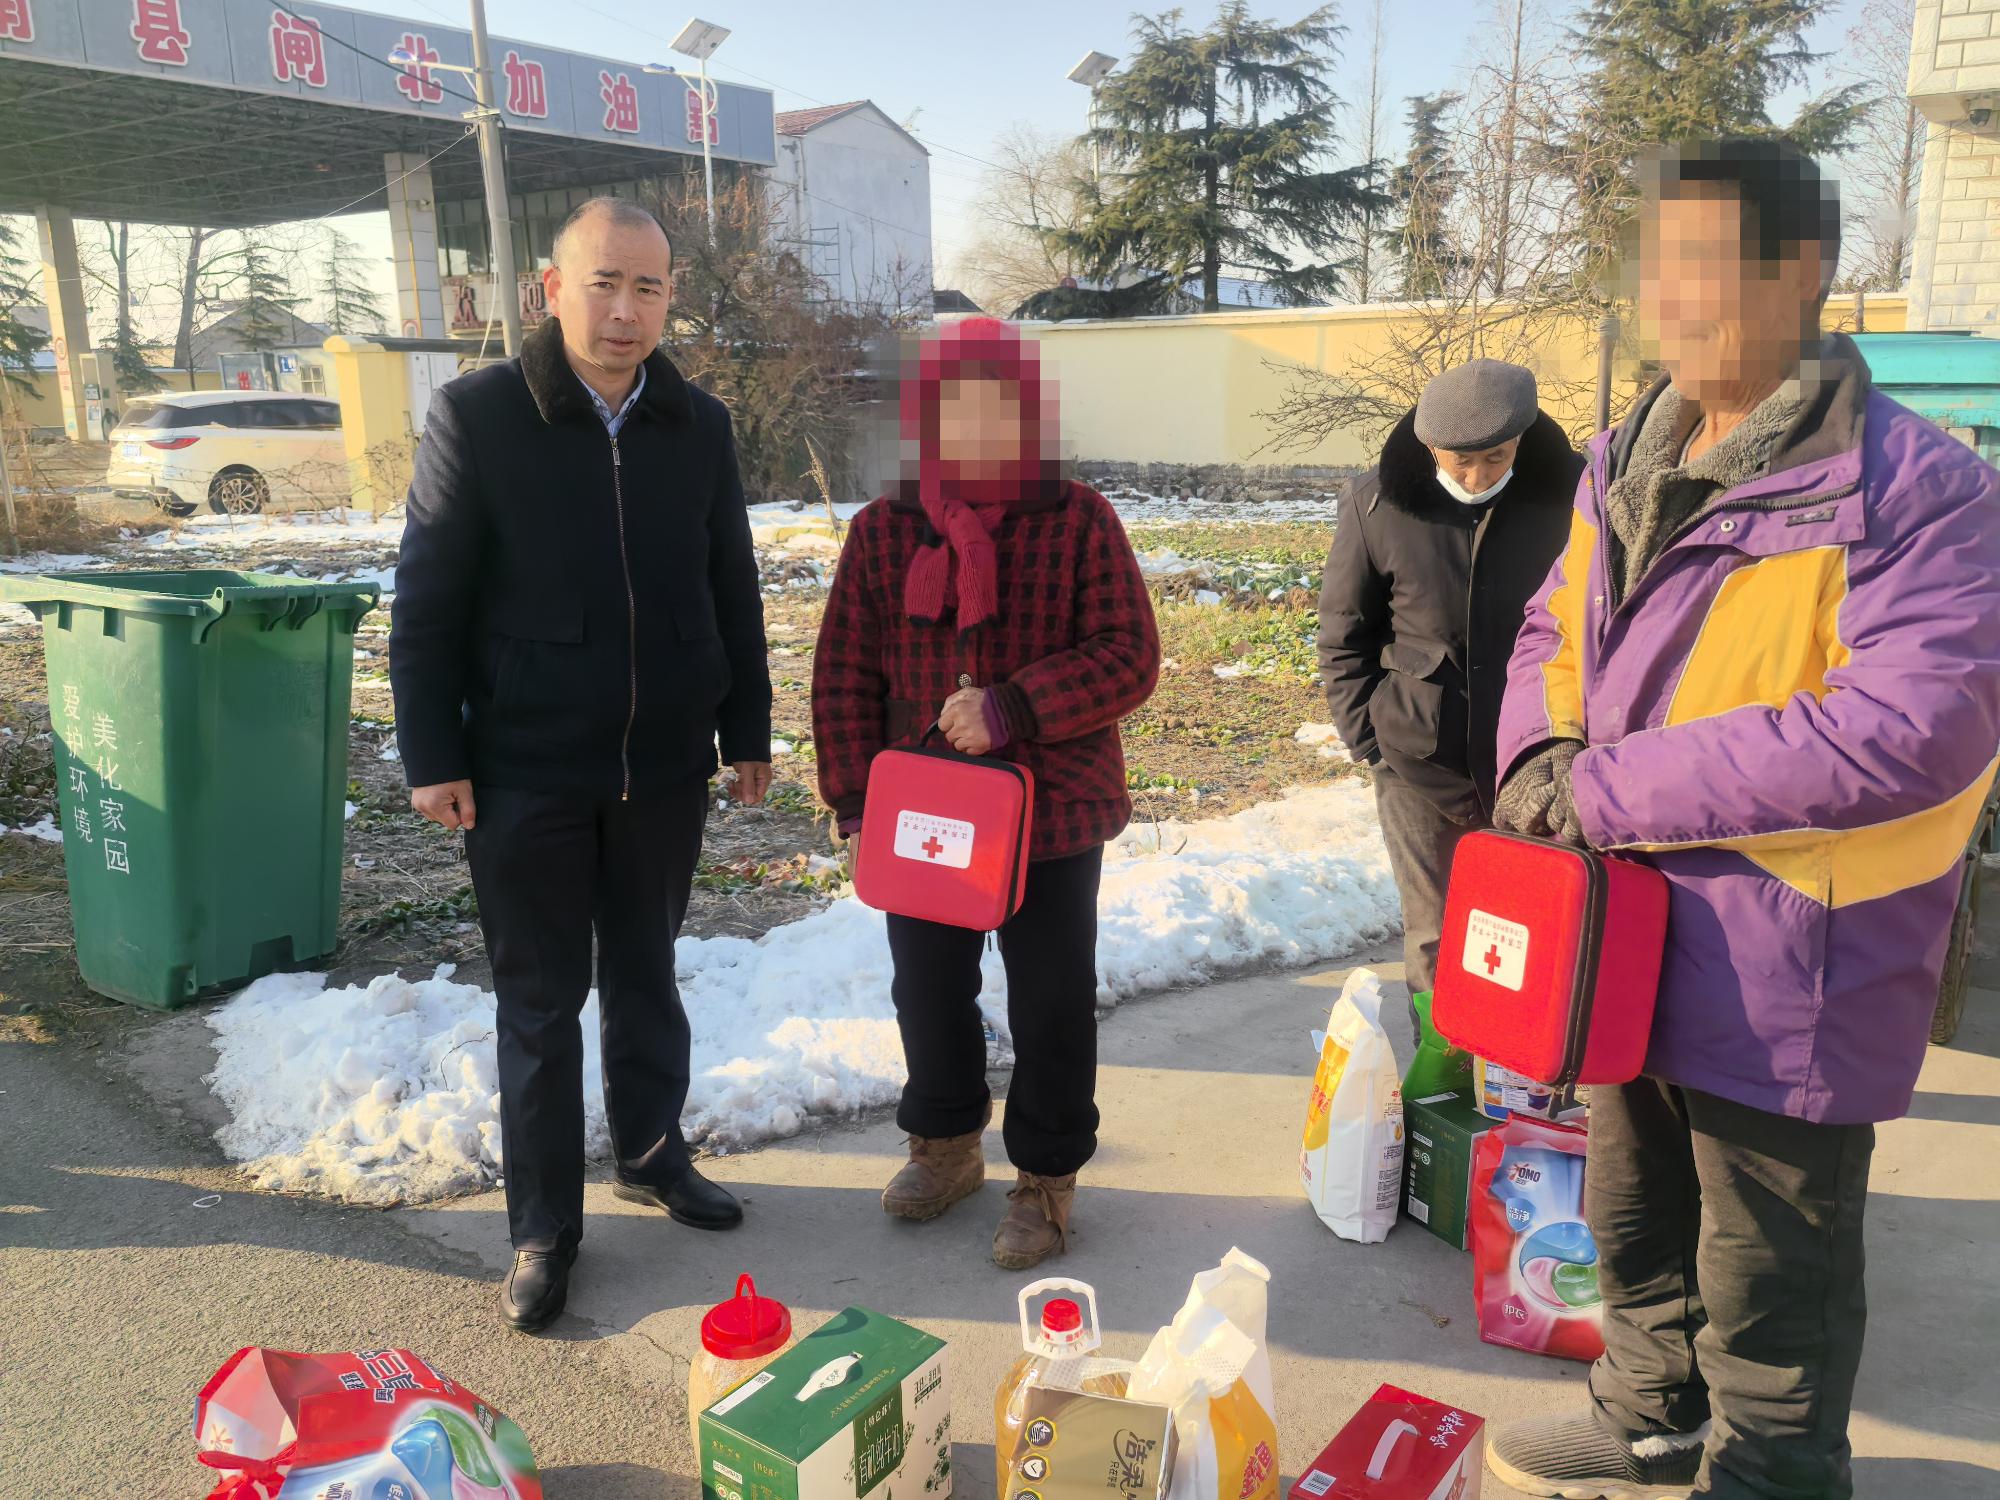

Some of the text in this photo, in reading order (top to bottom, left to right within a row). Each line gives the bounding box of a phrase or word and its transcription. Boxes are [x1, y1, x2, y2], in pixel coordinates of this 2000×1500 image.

[62, 684, 93, 843] 爱护环境
[92, 712, 130, 875] 美化家园
[1518, 1167, 1541, 1183] OMO
[859, 1423, 901, 1487] 有机纯牛奶
[1113, 1429, 1157, 1494] 洁柔
